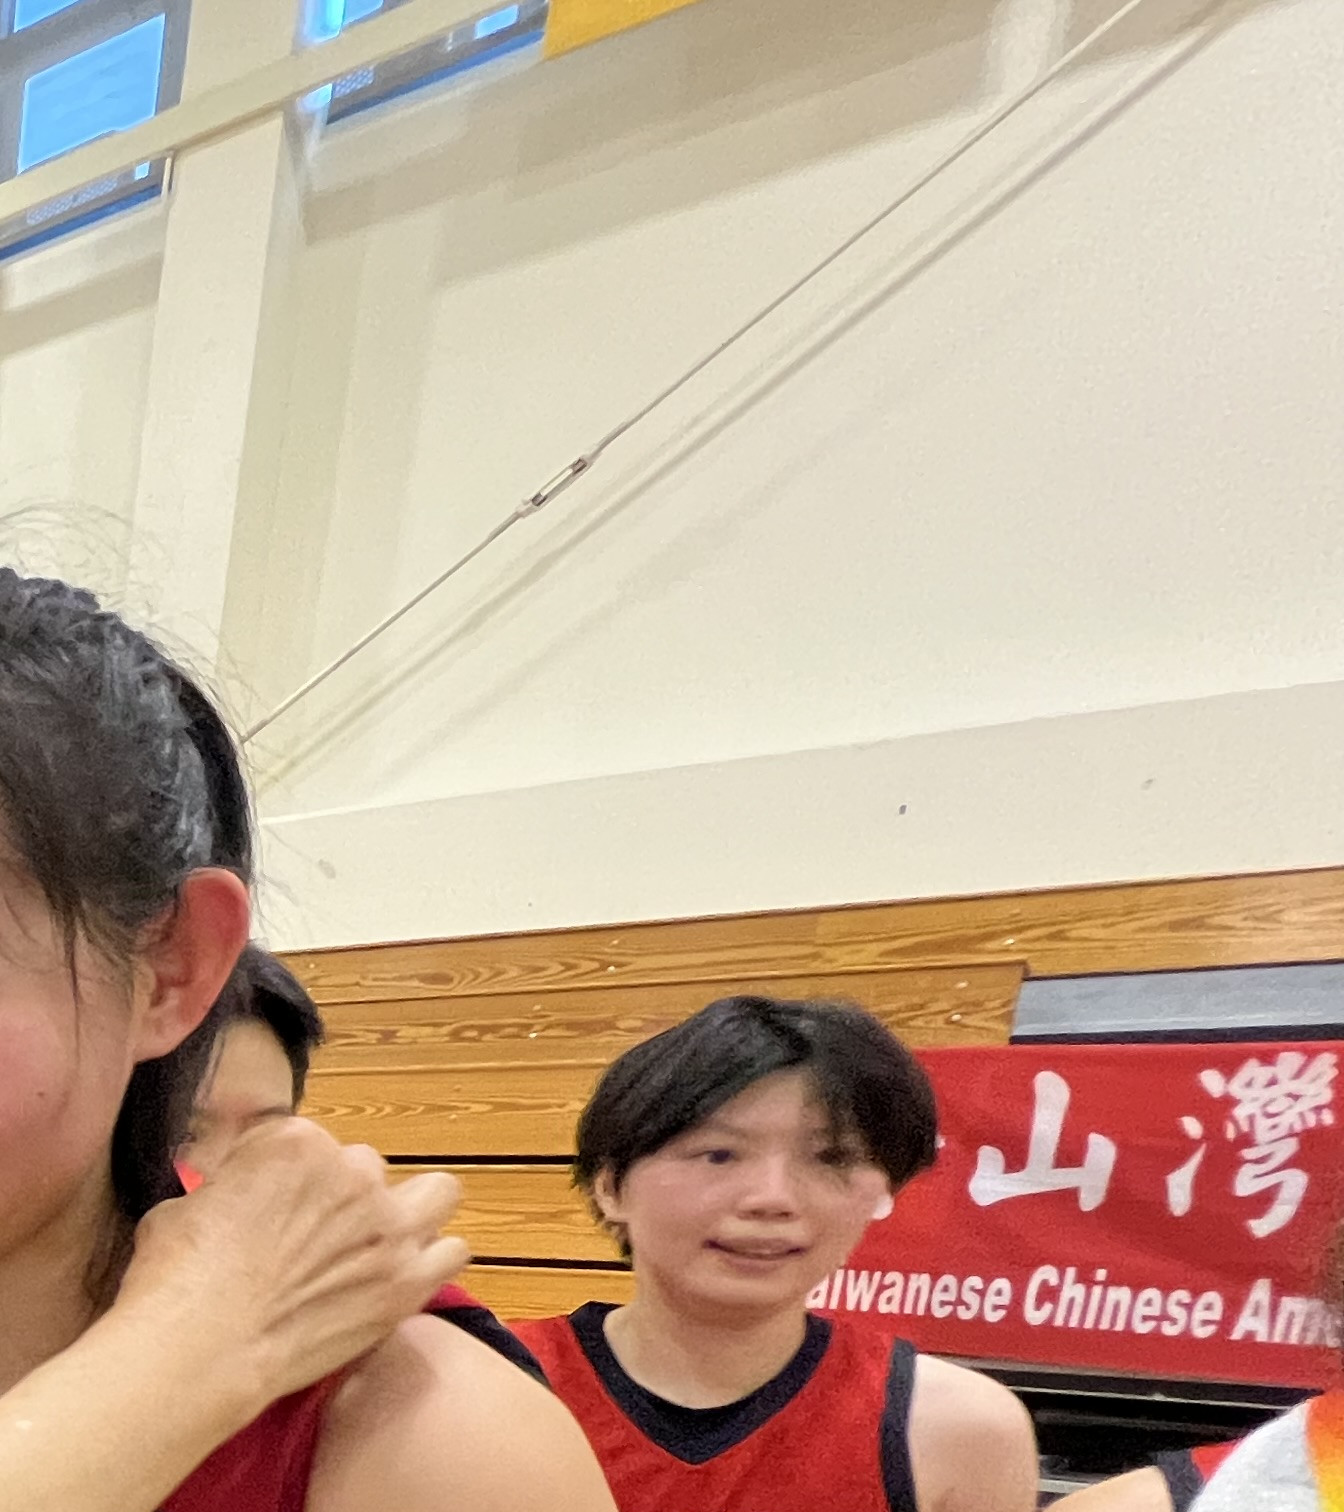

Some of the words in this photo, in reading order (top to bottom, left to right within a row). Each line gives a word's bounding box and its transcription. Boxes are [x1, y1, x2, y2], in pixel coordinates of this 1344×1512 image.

[968, 1050, 1340, 1239] 山灣
[805, 1266, 1013, 1324] aiwanese
[1024, 1263, 1224, 1339] Chinese
